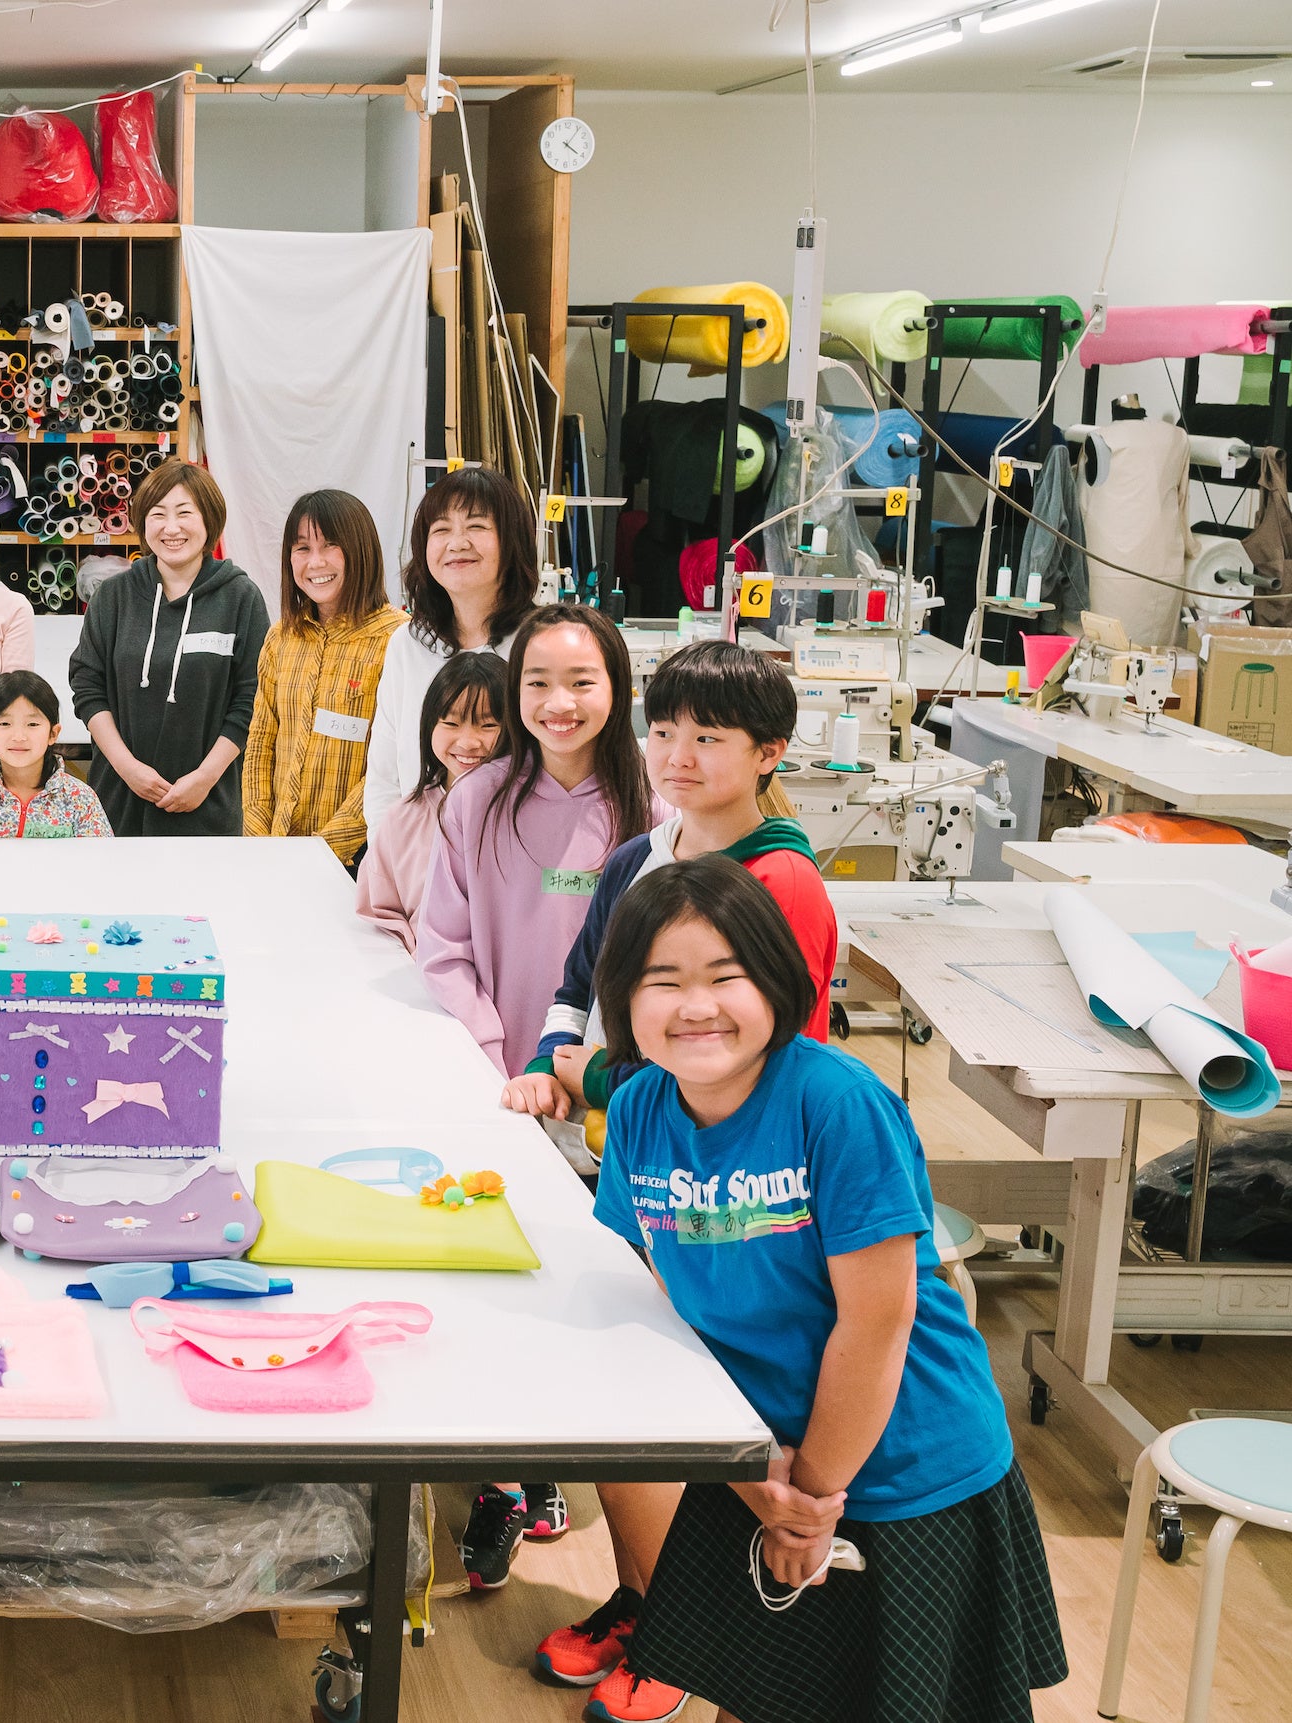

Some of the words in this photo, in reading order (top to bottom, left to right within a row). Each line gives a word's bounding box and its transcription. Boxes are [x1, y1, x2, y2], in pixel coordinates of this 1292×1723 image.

[555, 124, 561, 132] 11
[547, 131, 554, 139] 10
[581, 131, 587, 139] 2
[583, 141, 588, 149] 3
[554, 158, 559, 166] 7
[563, 160, 568, 168] 6
[1003, 463, 1009, 477] 3
[891, 493, 903, 508] 8
[551, 503, 560, 518] 9
[748, 584, 764, 606] 6
[830, 978, 847, 988] KI
[630, 1174, 646, 1186] THE
